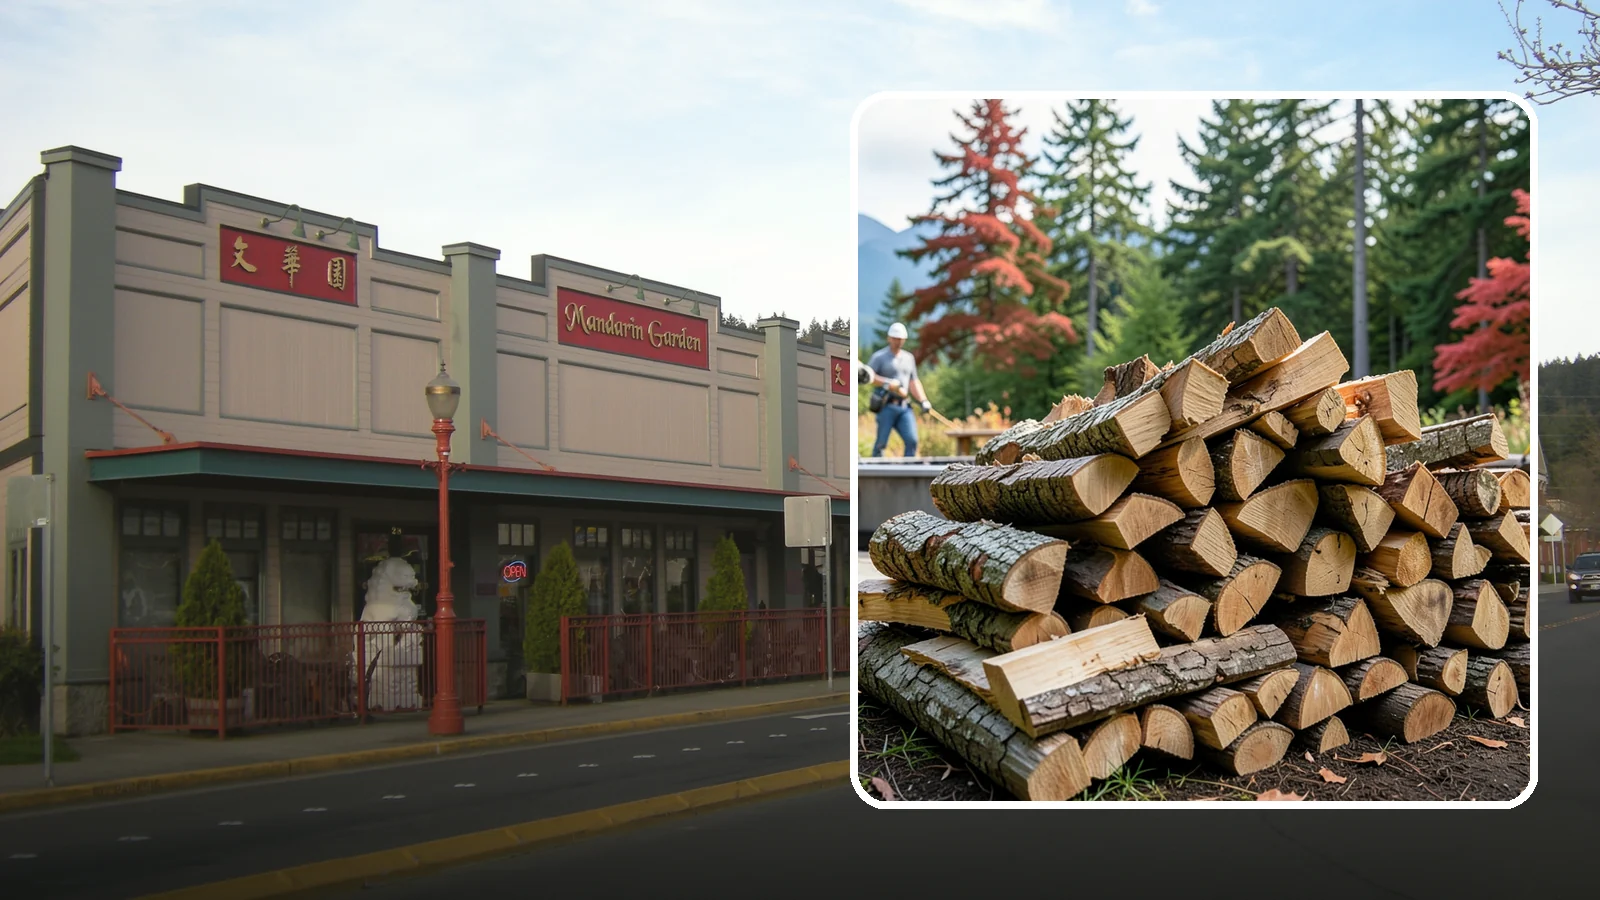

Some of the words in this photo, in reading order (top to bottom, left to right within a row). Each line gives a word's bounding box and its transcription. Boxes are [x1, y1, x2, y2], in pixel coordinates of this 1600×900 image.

[564, 302, 644, 341] Mandarin
[648, 320, 702, 352] Garden
[503, 565, 527, 578] OPEN
